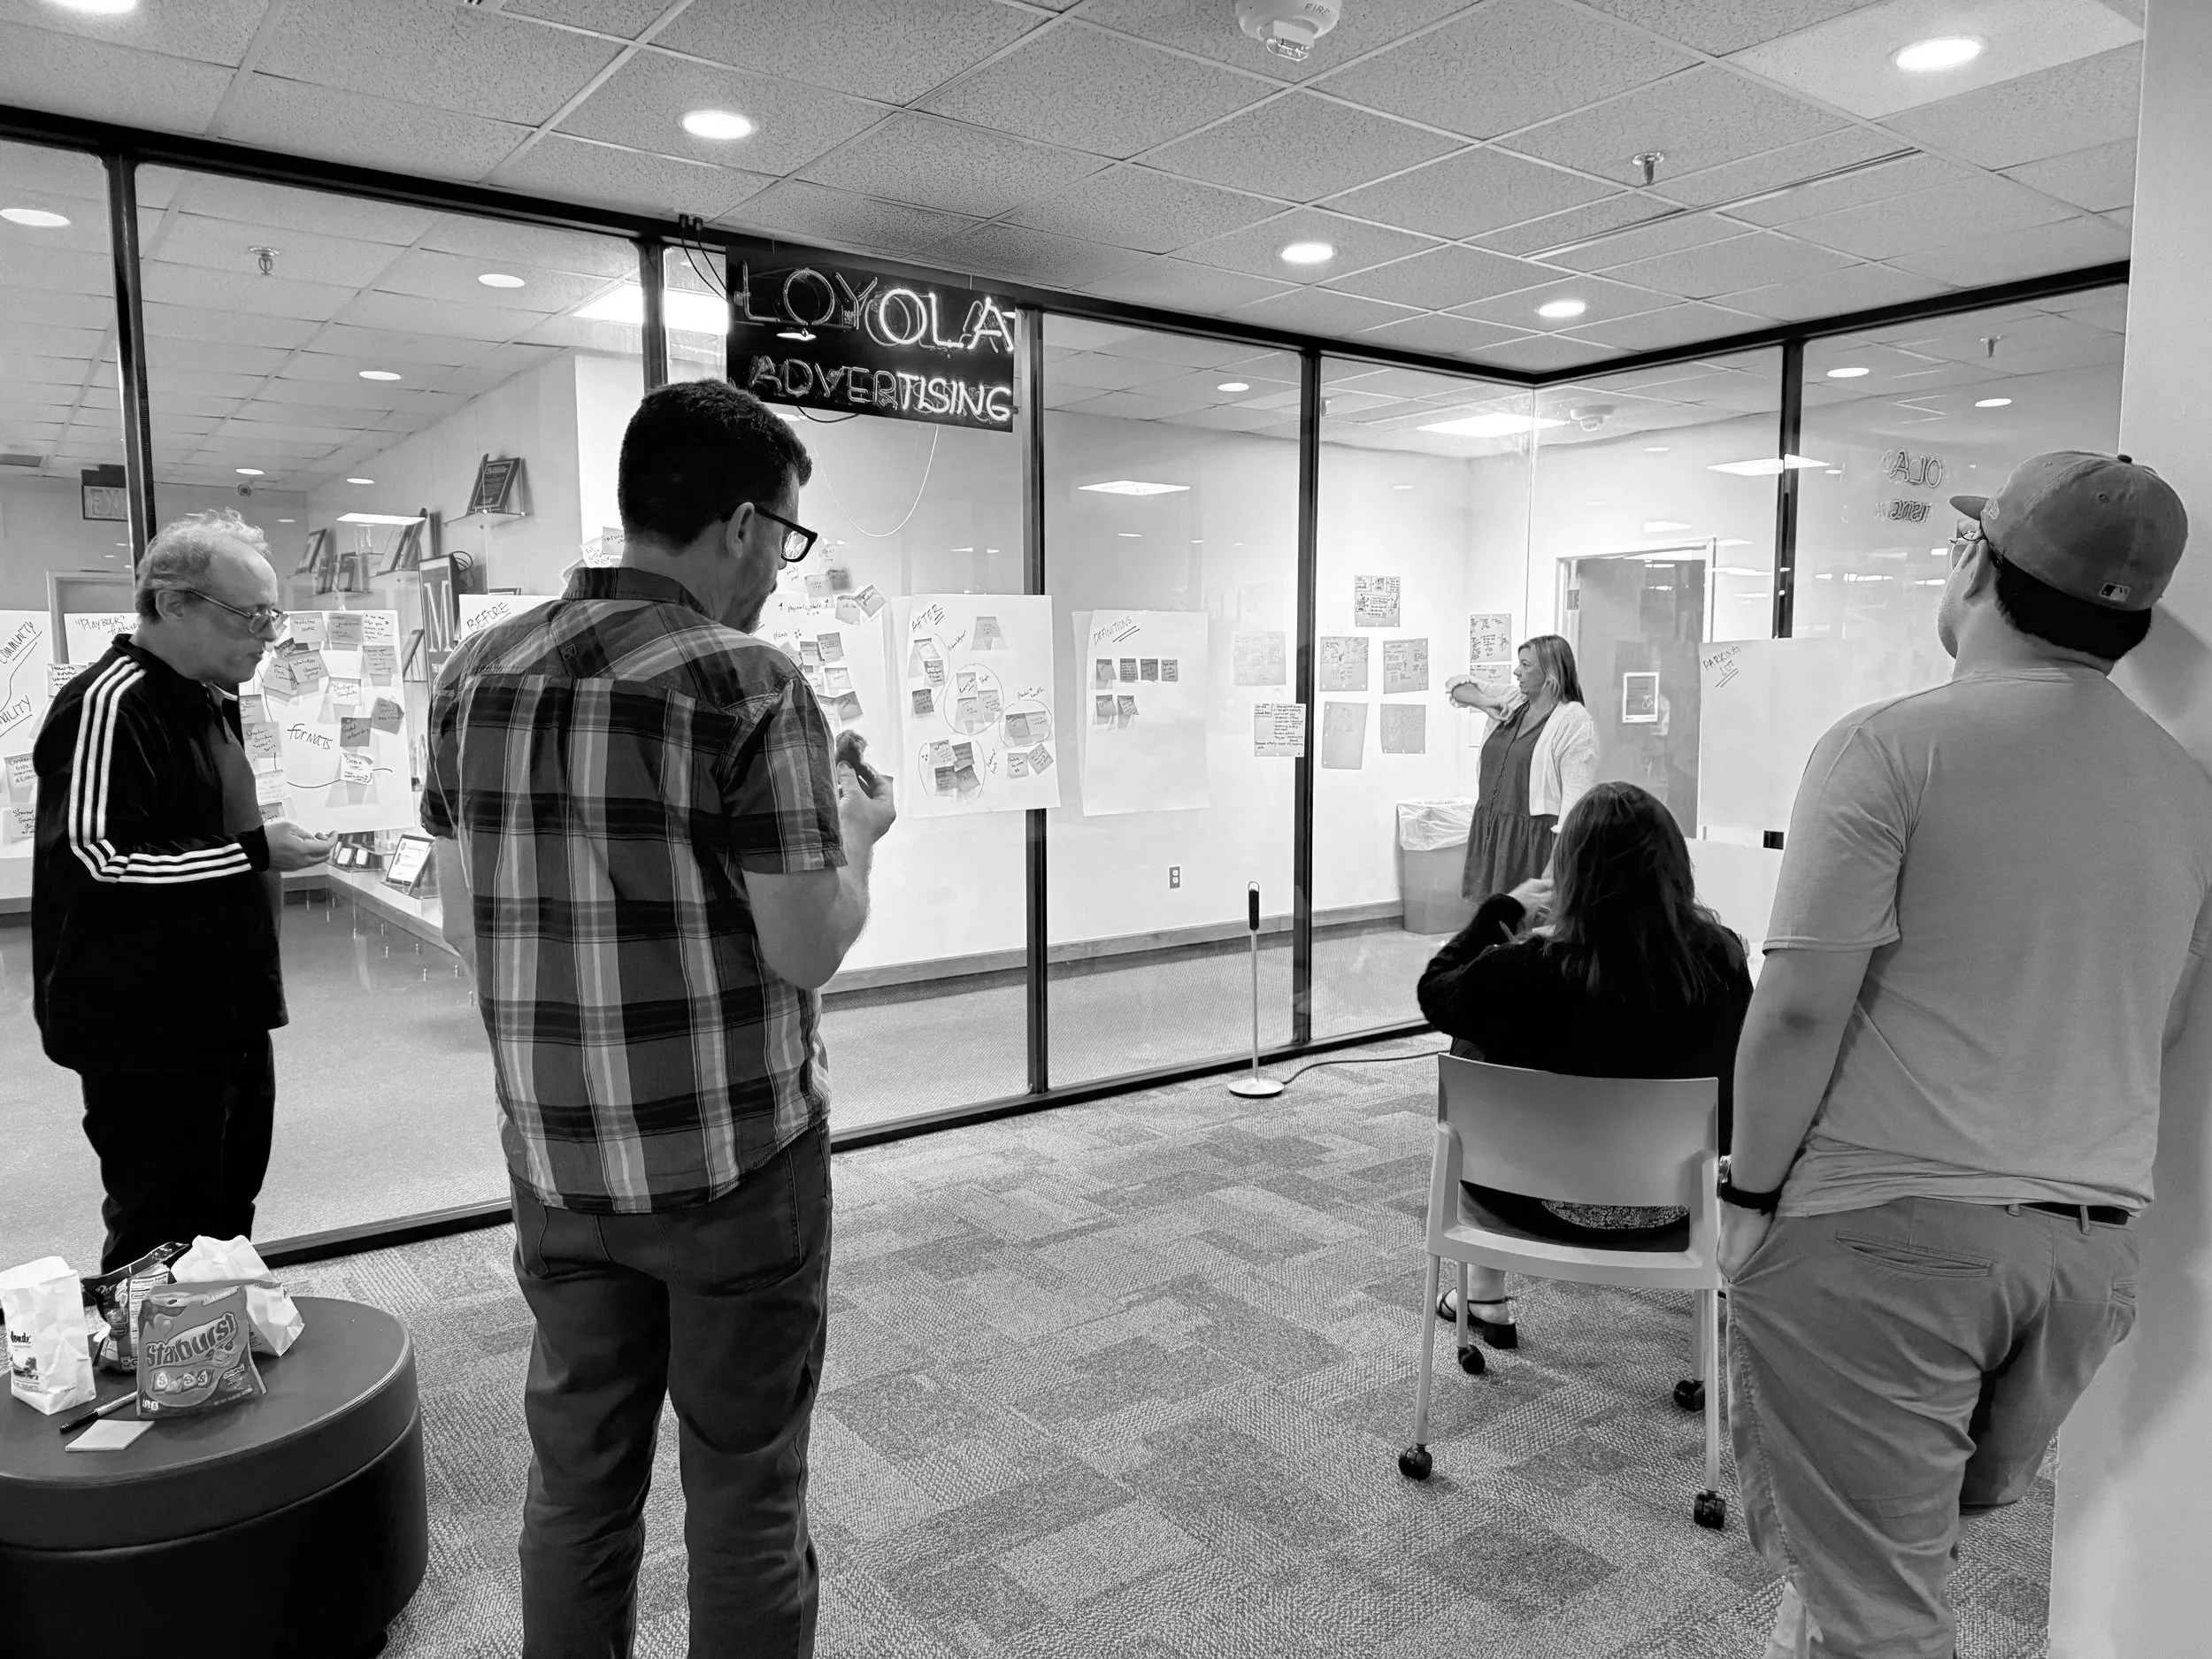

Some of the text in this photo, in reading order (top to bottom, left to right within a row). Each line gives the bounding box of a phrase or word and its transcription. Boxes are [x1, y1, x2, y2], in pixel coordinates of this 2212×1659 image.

[1304, 3, 1331, 15] FIRE
[741, 260, 1015, 353] LOYOLA
[749, 354, 1012, 422] ADVERTISING
[466, 603, 511, 632] BEFORE
[911, 603, 943, 634] AFTER
[1093, 616, 1133, 645] DEFINITIONS
[1702, 646, 1742, 671] PARKING
[1719, 659, 1734, 677] LOT
